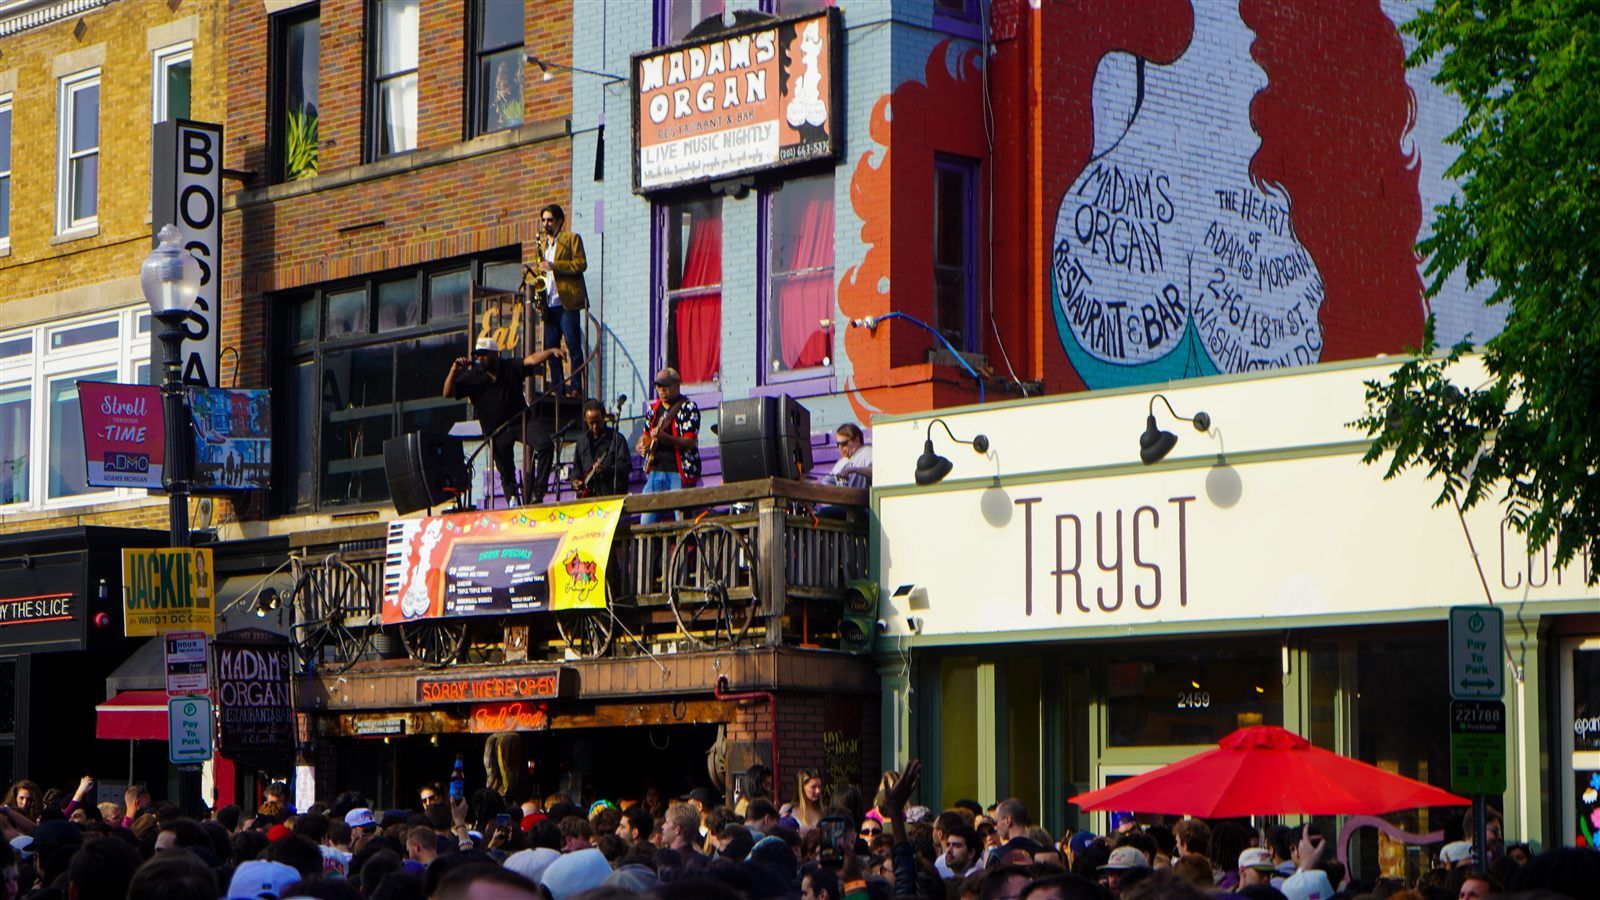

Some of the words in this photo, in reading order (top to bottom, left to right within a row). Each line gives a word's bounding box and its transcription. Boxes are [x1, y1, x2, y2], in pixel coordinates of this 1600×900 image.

[641, 30, 776, 93] MADAM'S
[649, 69, 767, 125] ORGAN
[737, 110, 755, 123] BAR
[646, 143, 677, 164] LIVE
[683, 135, 719, 156] MUSIC
[723, 124, 771, 149] NIGHTLY
[1077, 163, 1175, 224] MADAM'S
[1215, 189, 1239, 212] THE
[1241, 188, 1289, 237] HEART
[1075, 203, 1163, 274] ORGAN
[1248, 231, 1262, 253] OF
[179, 129, 215, 387] BOSSA
[1203, 220, 1253, 281] ADAMS
[1258, 246, 1311, 294] MORGAN
[1054, 238, 1128, 359] RESTAURANT
[1142, 283, 1188, 350] BAR
[1207, 268, 1252, 332] 2461
[1250, 313, 1285, 349] 18TH
[1302, 276, 1325, 309] NW
[477, 301, 523, 351] Eat
[100, 395, 148, 417] Stroll
[104, 424, 147, 443] TIME
[105, 454, 149, 471] ADMO
[500, 547, 533, 560] SPECIALS
[1014, 495, 1196, 617] TRYST
[126, 553, 194, 611] JACKIE
[11, 600, 34, 620] THE
[35, 598, 70, 617] SLICE
[137, 615, 161, 625] WARD
[161, 615, 167, 625] 1
[170, 615, 186, 624] DC
[177, 641, 197, 649] HOUR
[1466, 639, 1487, 651] Pay
[220, 649, 289, 680] MADAM'S
[1465, 664, 1489, 675] Park
[1470, 652, 1484, 664] To
[220, 681, 290, 707] ORGAN
[471, 678, 514, 699] WE'RE
[517, 675, 557, 697] OPEN
[1177, 692, 1211, 709] 2459
[182, 720, 199, 729] Pay
[185, 729, 197, 737] To
